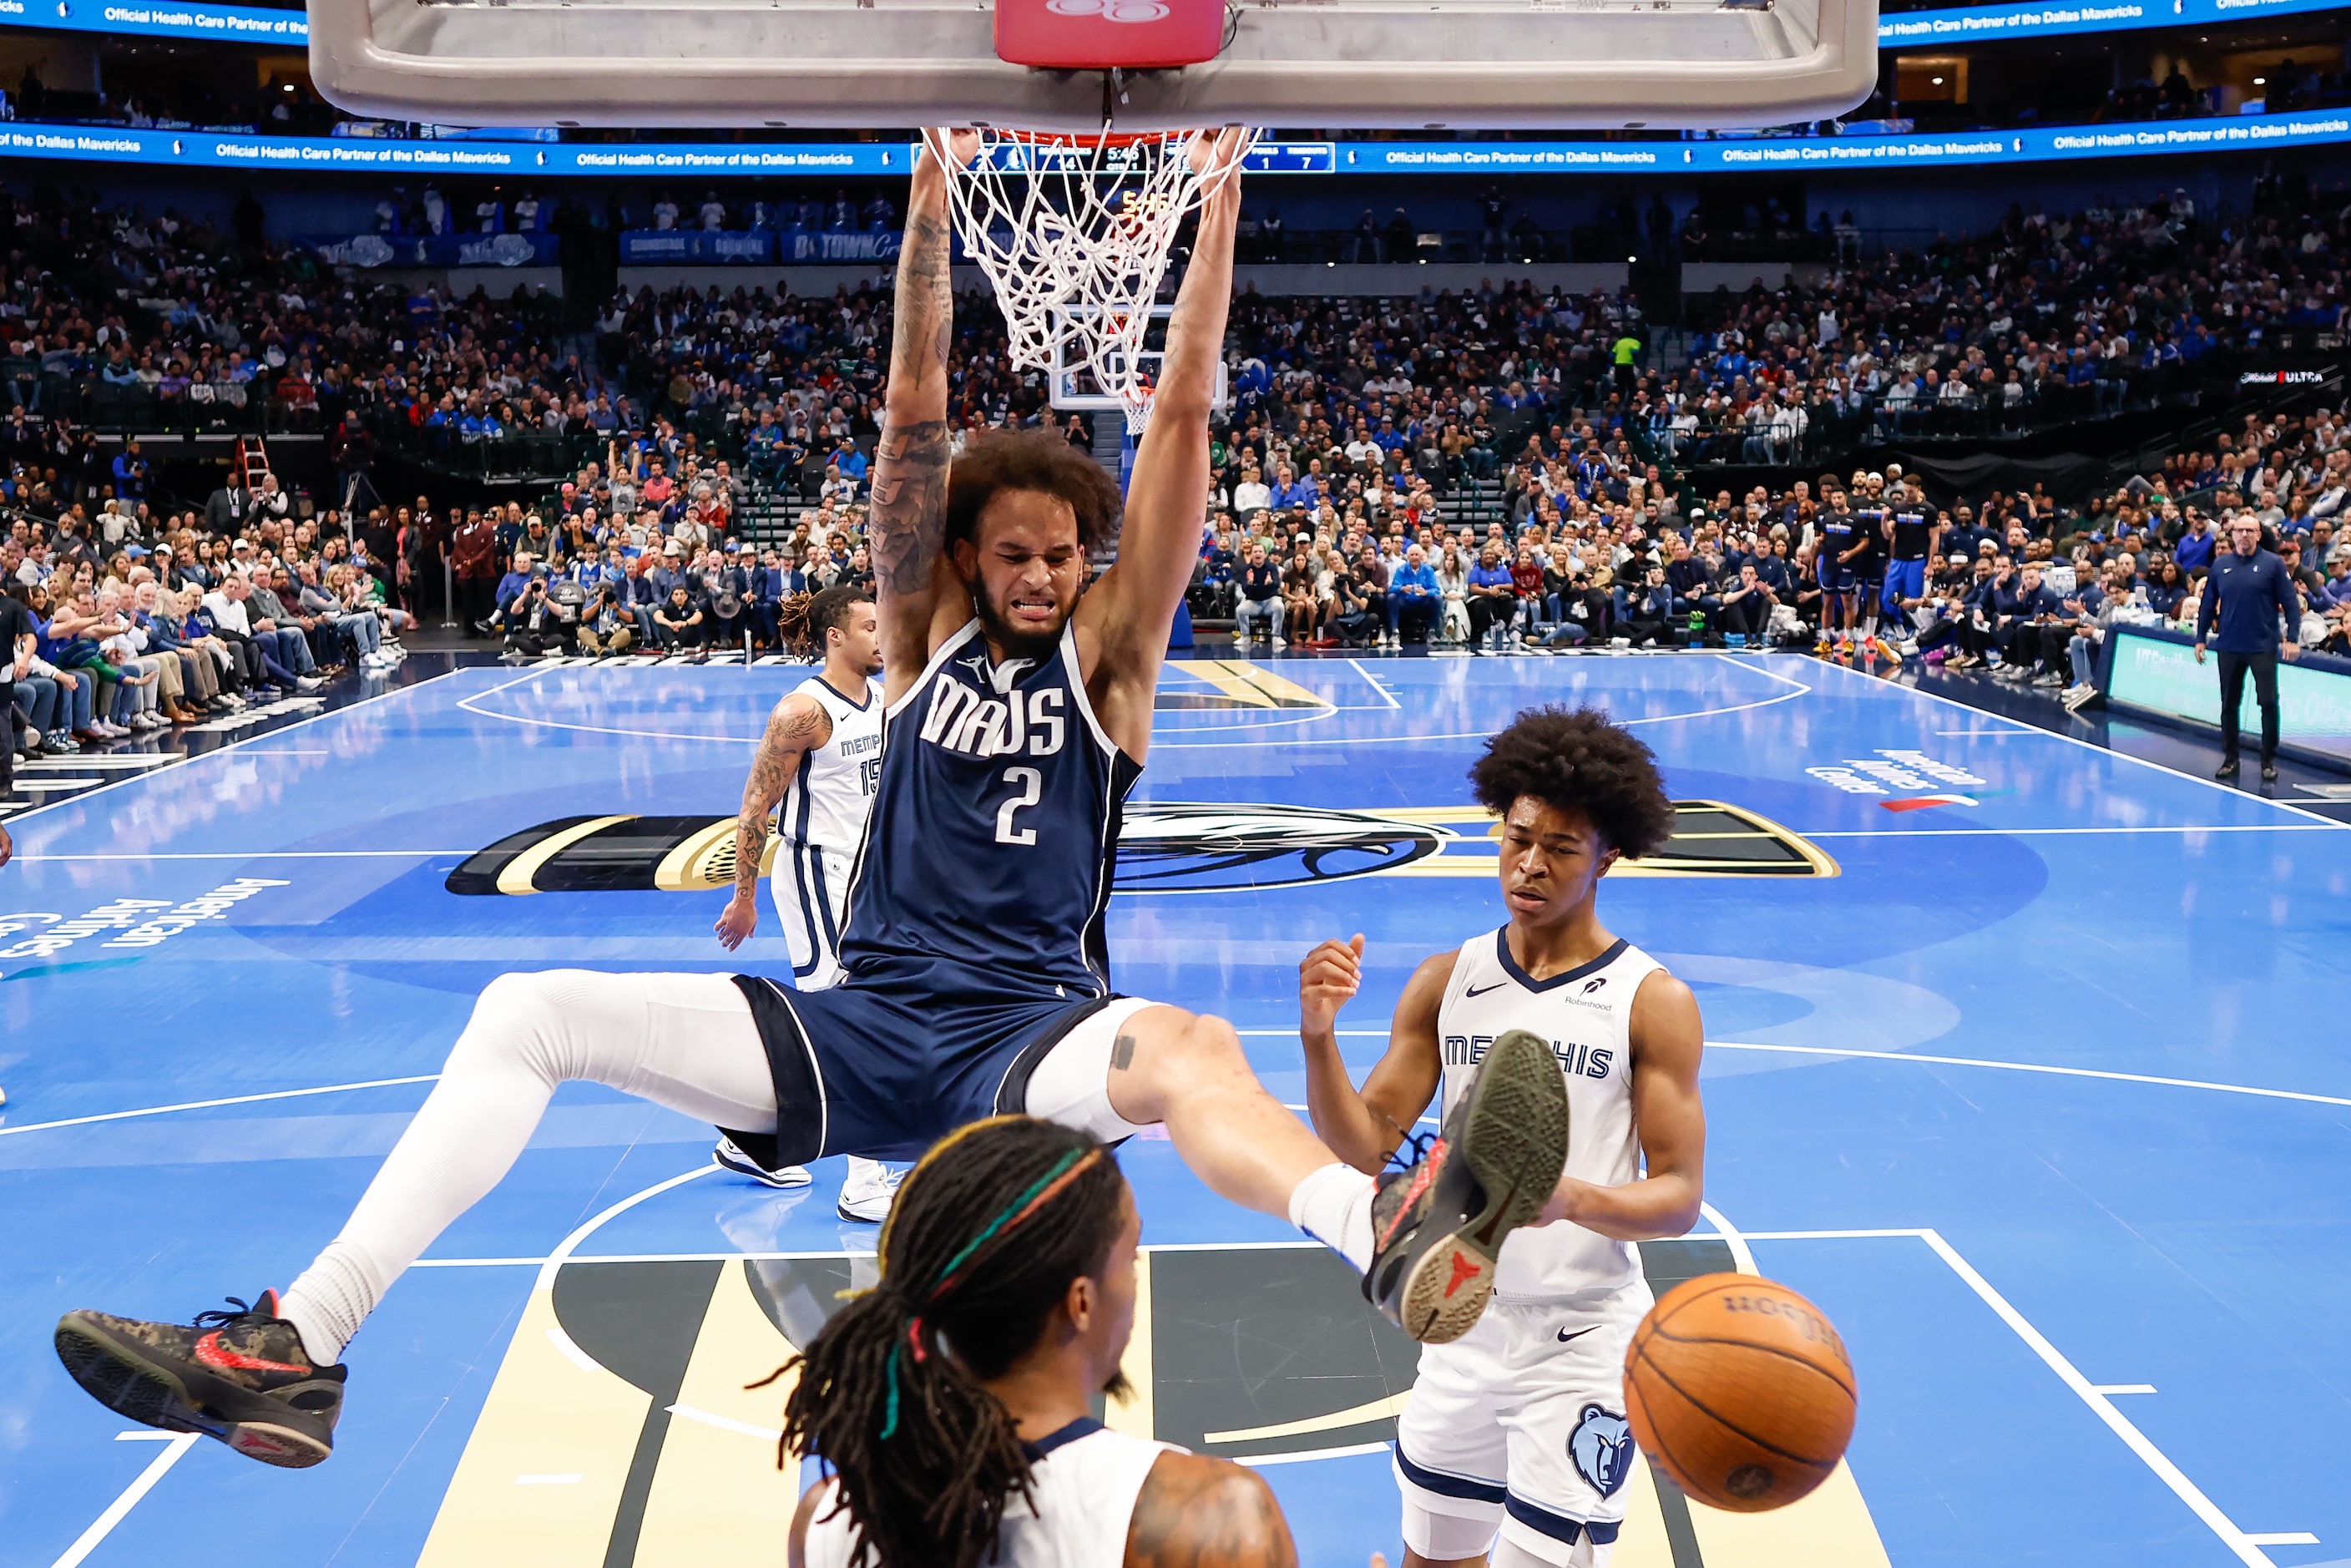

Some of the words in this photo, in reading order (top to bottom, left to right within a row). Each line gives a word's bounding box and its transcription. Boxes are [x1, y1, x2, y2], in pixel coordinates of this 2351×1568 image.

[104, 8, 149, 23] Official
[152, 11, 193, 26] Health
[195, 13, 225, 28] Care
[227, 16, 272, 32] Partner
[274, 18, 288, 33] of
[289, 18, 308, 34] the
[1895, 22, 1932, 35] Health
[1934, 19, 1961, 33] Care
[1963, 17, 2005, 30] Partner
[2007, 14, 2020, 27] of
[2022, 13, 2041, 25] the
[2043, 10, 2080, 23] Dallas
[2082, 6, 2143, 21] Mavericks
[13, 134, 33, 147] the
[36, 135, 75, 149] Dallas
[78, 137, 141, 152] Mavericks
[2054, 136, 2095, 149] Official
[2097, 134, 2135, 147] Health
[2136, 132, 2166, 144] Care
[2167, 129, 2212, 143] Partner
[2213, 128, 2227, 141] of
[2228, 127, 2249, 139] the
[2250, 124, 2288, 138] Dallas
[2289, 120, 2348, 135] Mavericks
[216, 144, 259, 158] Official
[260, 145, 300, 159] Health
[301, 147, 331, 159] Care
[333, 148, 376, 161] Partner
[378, 149, 392, 161] of
[392, 149, 412, 162] the
[414, 150, 450, 163] Dallas
[453, 151, 511, 165] Mavericks
[577, 153, 616, 165] Official
[619, 154, 655, 165] Health
[656, 154, 683, 165] Care
[685, 154, 726, 165] Partner
[728, 154, 740, 165] of
[741, 154, 760, 165] the
[761, 154, 796, 165] Dallas
[797, 154, 853, 165] Mavericks
[1386, 151, 1423, 164] Official
[1426, 152, 1462, 164] Health
[1463, 152, 1490, 164] Care
[1491, 152, 1532, 164] Partner
[1533, 152, 1545, 164] of
[1545, 152, 1565, 164] the
[1566, 151, 1600, 164] Dallas
[1601, 151, 1656, 164] Mavericks
[1722, 149, 1762, 162] Official
[1764, 149, 1800, 161] Health
[1801, 148, 1828, 159] Care
[1830, 146, 1873, 159] Partner
[1873, 145, 1887, 157] of
[1888, 144, 1906, 157] the
[1908, 144, 1944, 155] Dallas
[1945, 141, 2003, 154] Mavericks
[1261, 157, 1269, 170] 1
[1302, 157, 1312, 170] 7
[528, 655, 827, 667] DALLA
[919, 672, 1065, 757] MAVS
[841, 734, 882, 757] MEMP
[860, 757, 882, 797] 15
[994, 766, 1043, 846] 2
[100, 878, 291, 948] American
[1565, 995, 1613, 1012] Robinhood
[1444, 1035, 1613, 1080] MEHIS
